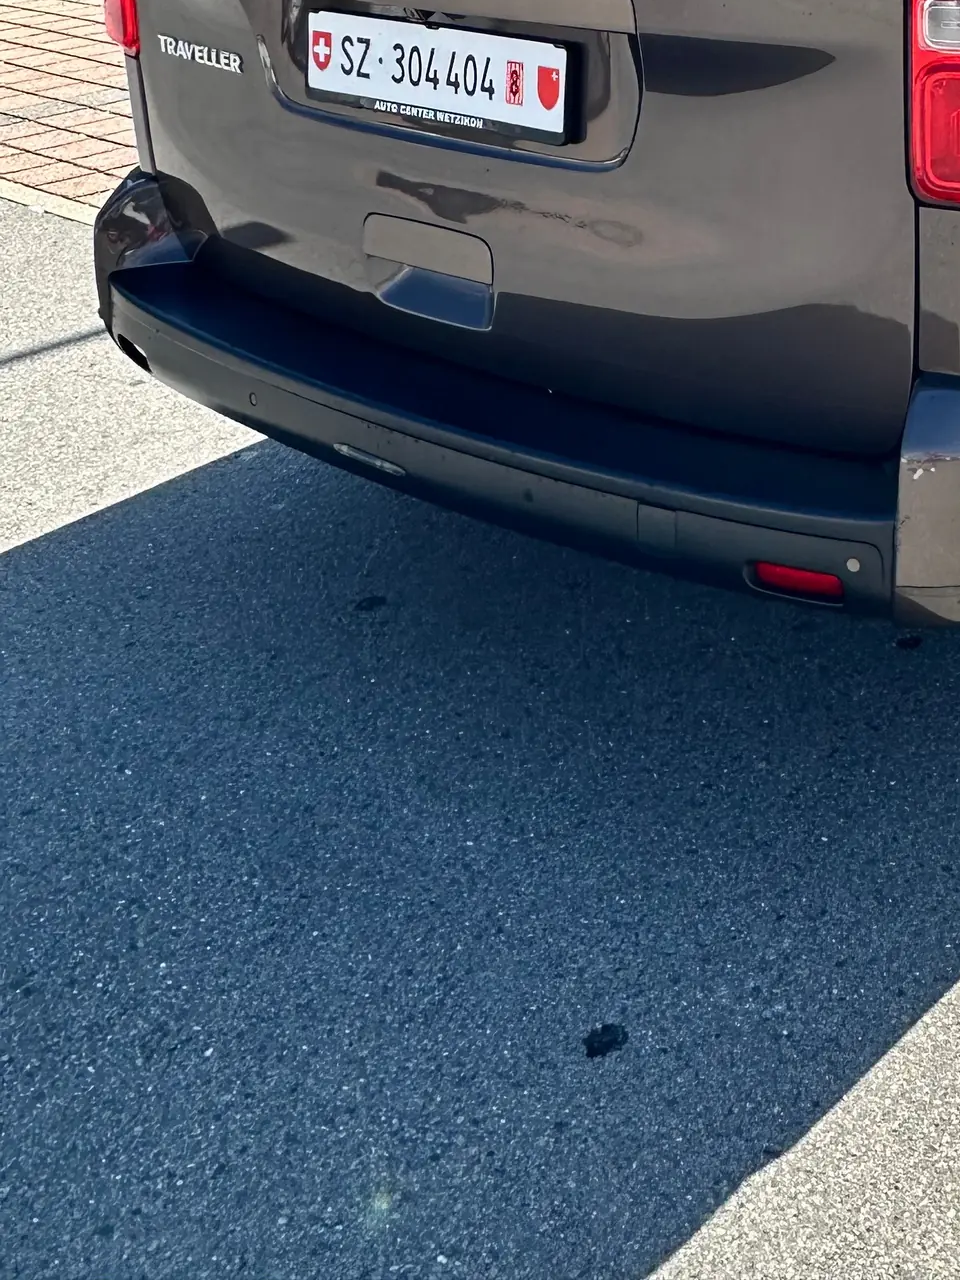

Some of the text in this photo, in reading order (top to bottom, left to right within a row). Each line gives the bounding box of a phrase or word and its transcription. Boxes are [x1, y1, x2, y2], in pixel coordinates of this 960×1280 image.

[157, 34, 243, 74] TRAVELLER
[374, 100, 484, 129] AUTO CENTER WETZIKON
